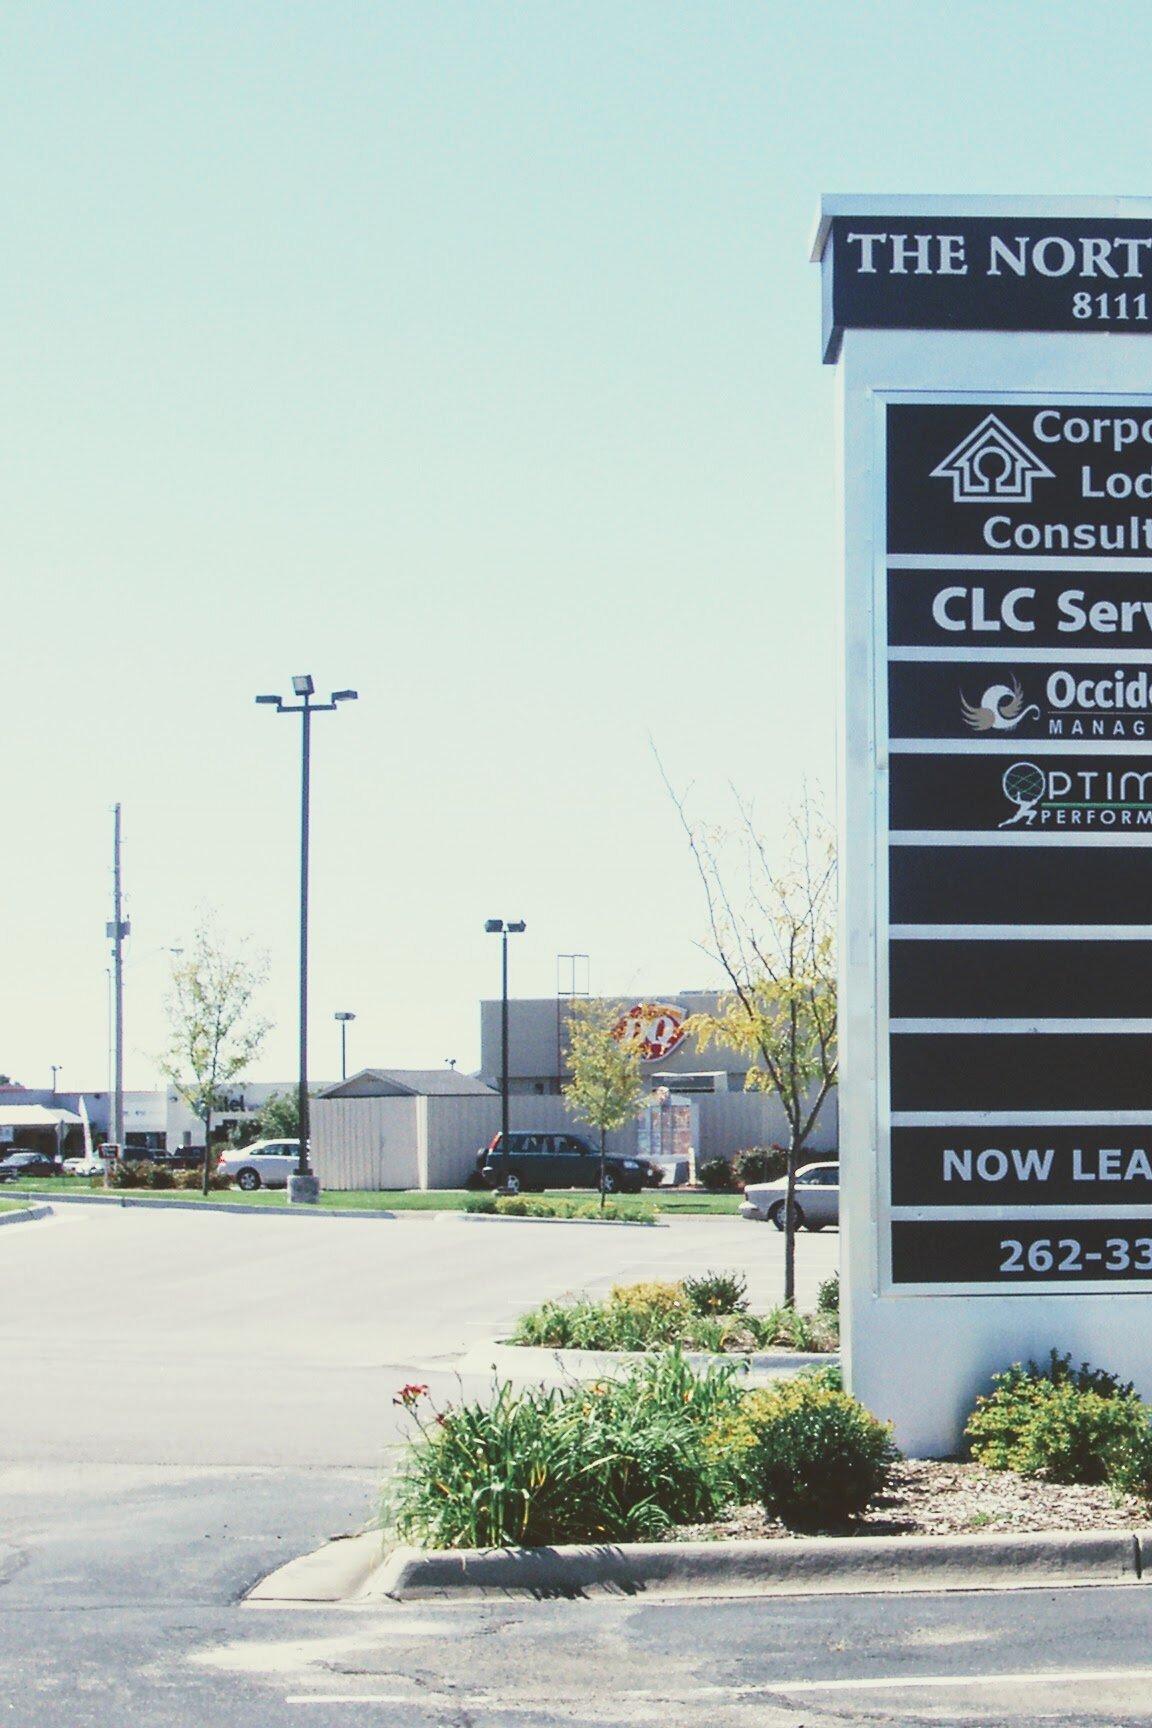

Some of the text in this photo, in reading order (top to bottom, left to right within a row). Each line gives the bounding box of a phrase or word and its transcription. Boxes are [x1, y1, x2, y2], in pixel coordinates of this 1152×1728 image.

[847, 232, 968, 275] THE
[1071, 291, 1149, 320] 8111
[931, 585, 1036, 632] CLC
[943, 1148, 1055, 1182] NOW
